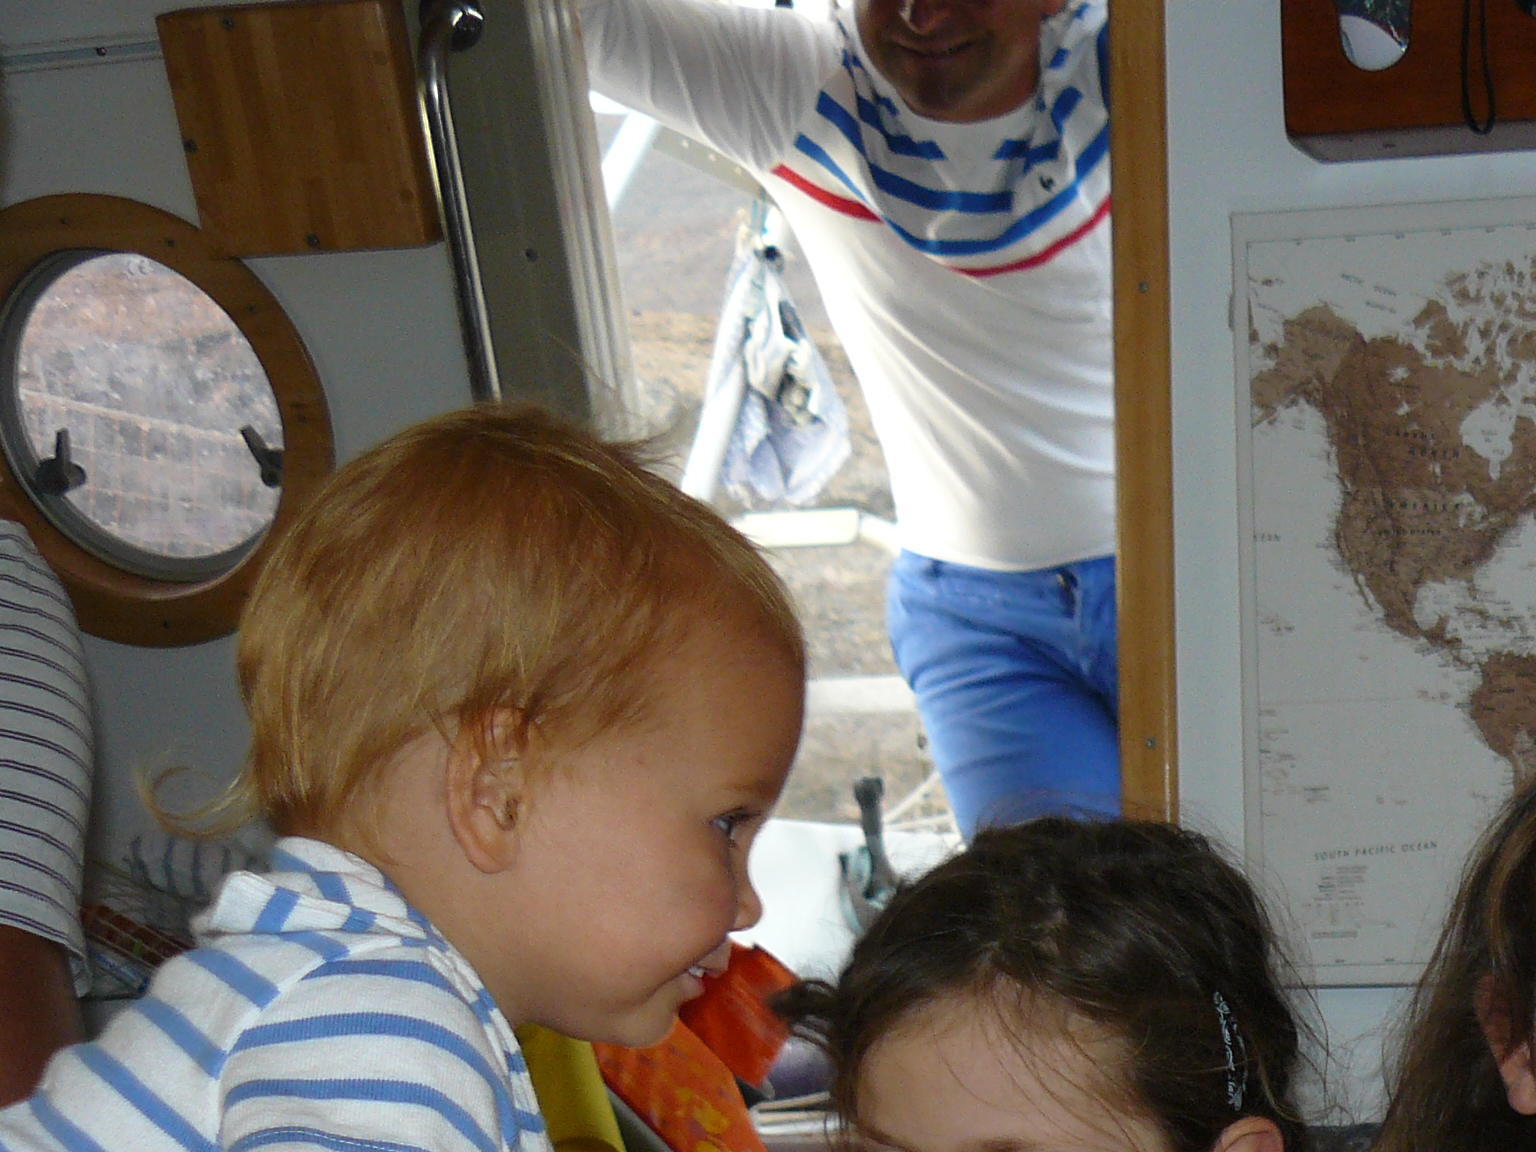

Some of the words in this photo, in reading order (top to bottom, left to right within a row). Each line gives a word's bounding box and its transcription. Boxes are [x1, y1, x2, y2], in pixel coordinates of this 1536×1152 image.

[1314, 851, 1350, 861] SOUTH
[1356, 844, 1396, 857] PACIFIC
[1402, 841, 1437, 853] OCEAN
